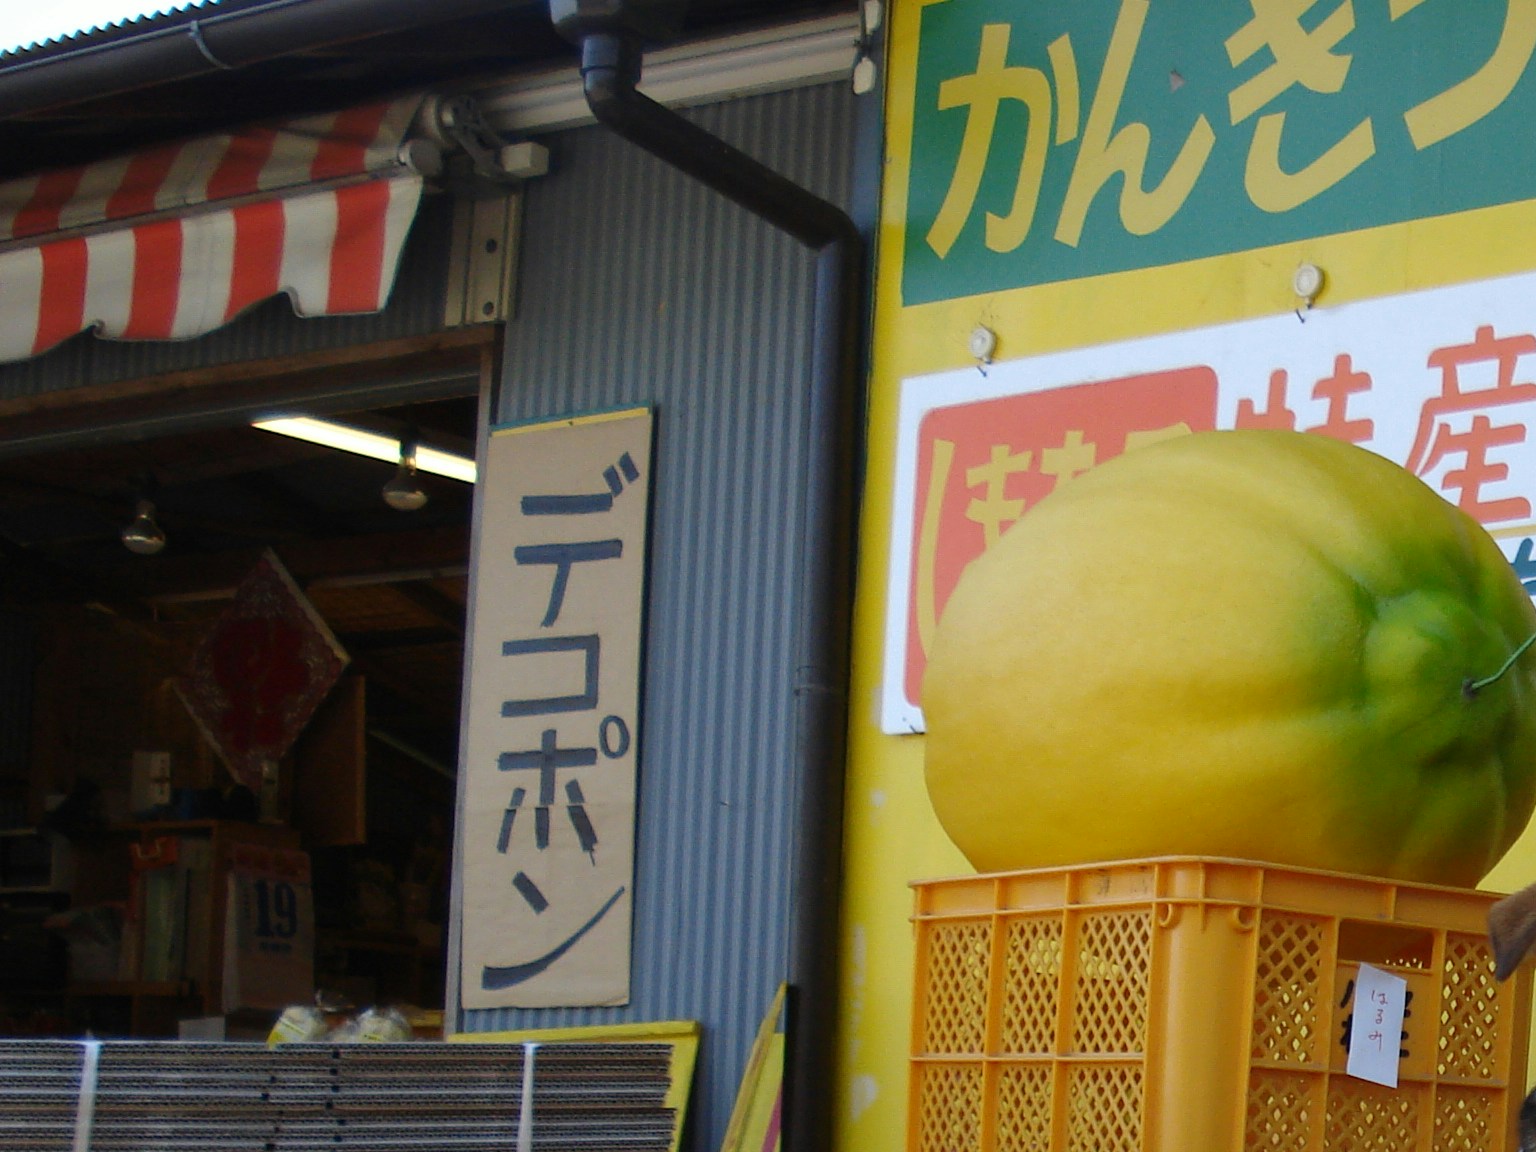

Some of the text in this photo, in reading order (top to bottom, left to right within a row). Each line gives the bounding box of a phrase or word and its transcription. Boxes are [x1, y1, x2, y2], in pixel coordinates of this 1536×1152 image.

[481, 452, 640, 991] デコポン
[254, 879, 298, 938] 19
